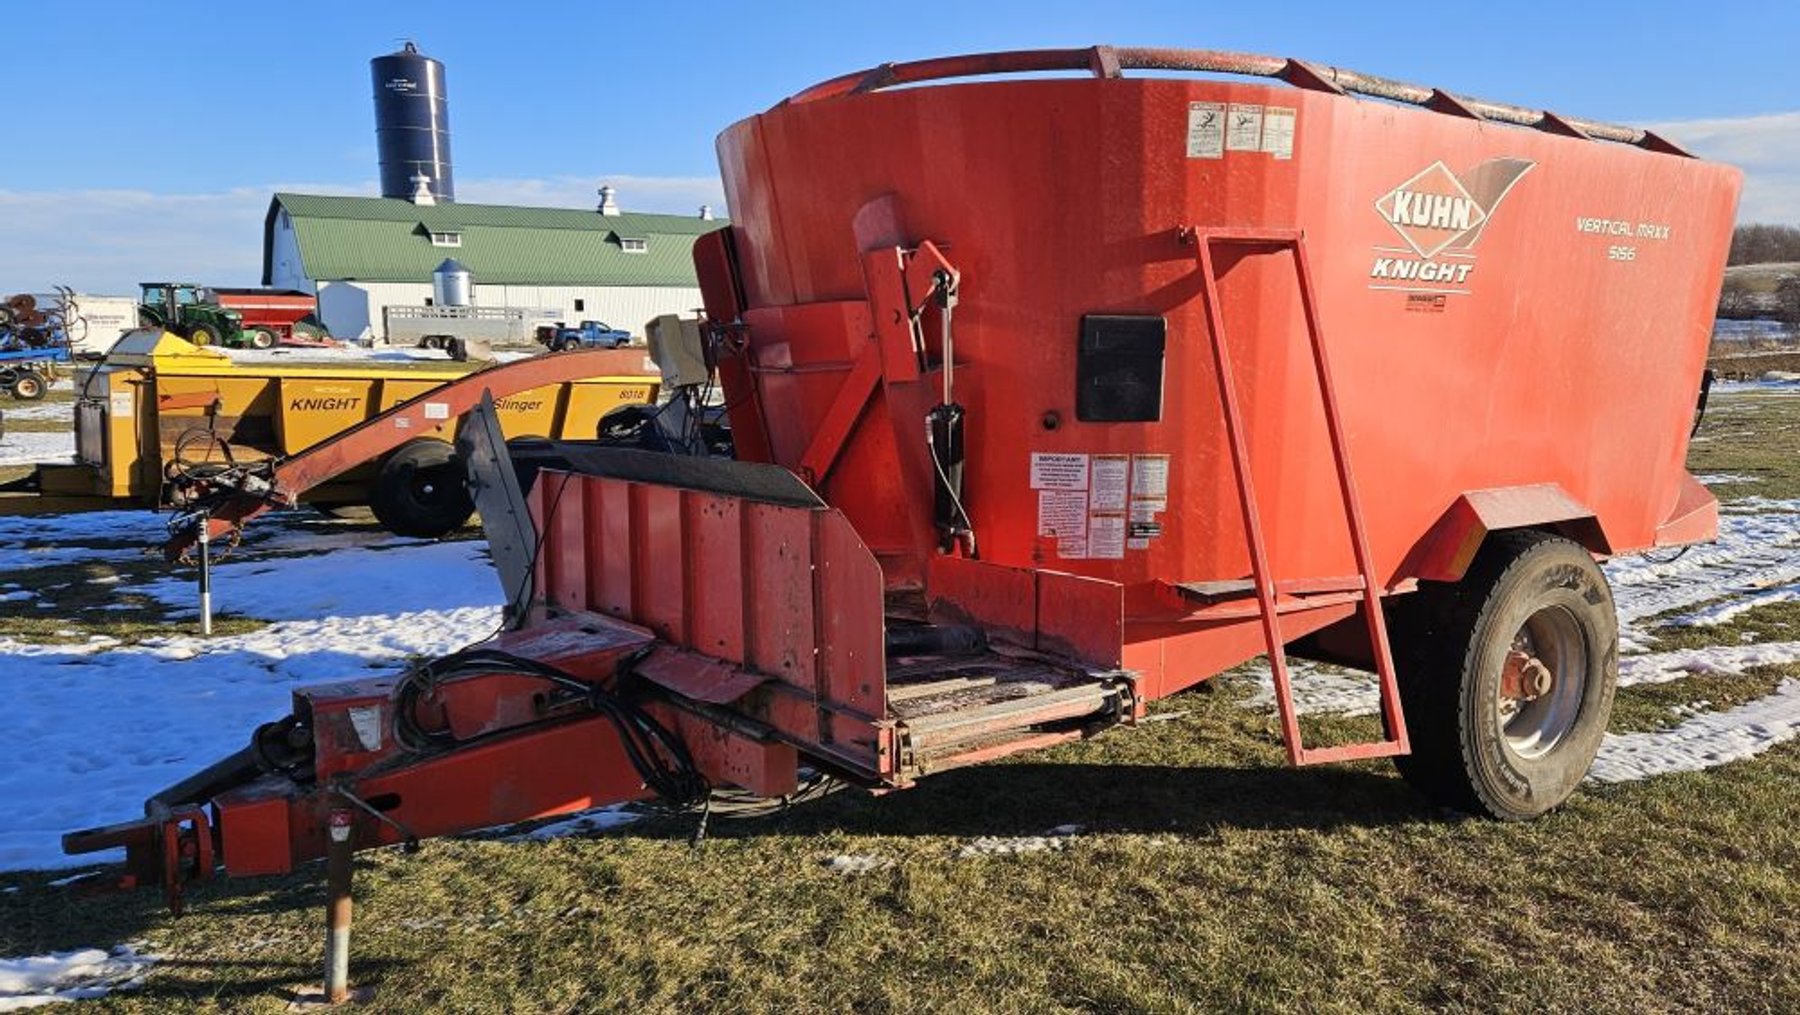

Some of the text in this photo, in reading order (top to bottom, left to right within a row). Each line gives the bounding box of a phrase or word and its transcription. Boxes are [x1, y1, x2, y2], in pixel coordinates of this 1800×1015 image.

[1392, 190, 1471, 231] KUHN
[1576, 216, 1670, 239] VERTICAL MAXX
[1608, 245, 1637, 261] 5156
[1370, 258, 1473, 283] KNIGHT
[290, 398, 361, 411] KNIGHT
[493, 398, 544, 412] Slinger
